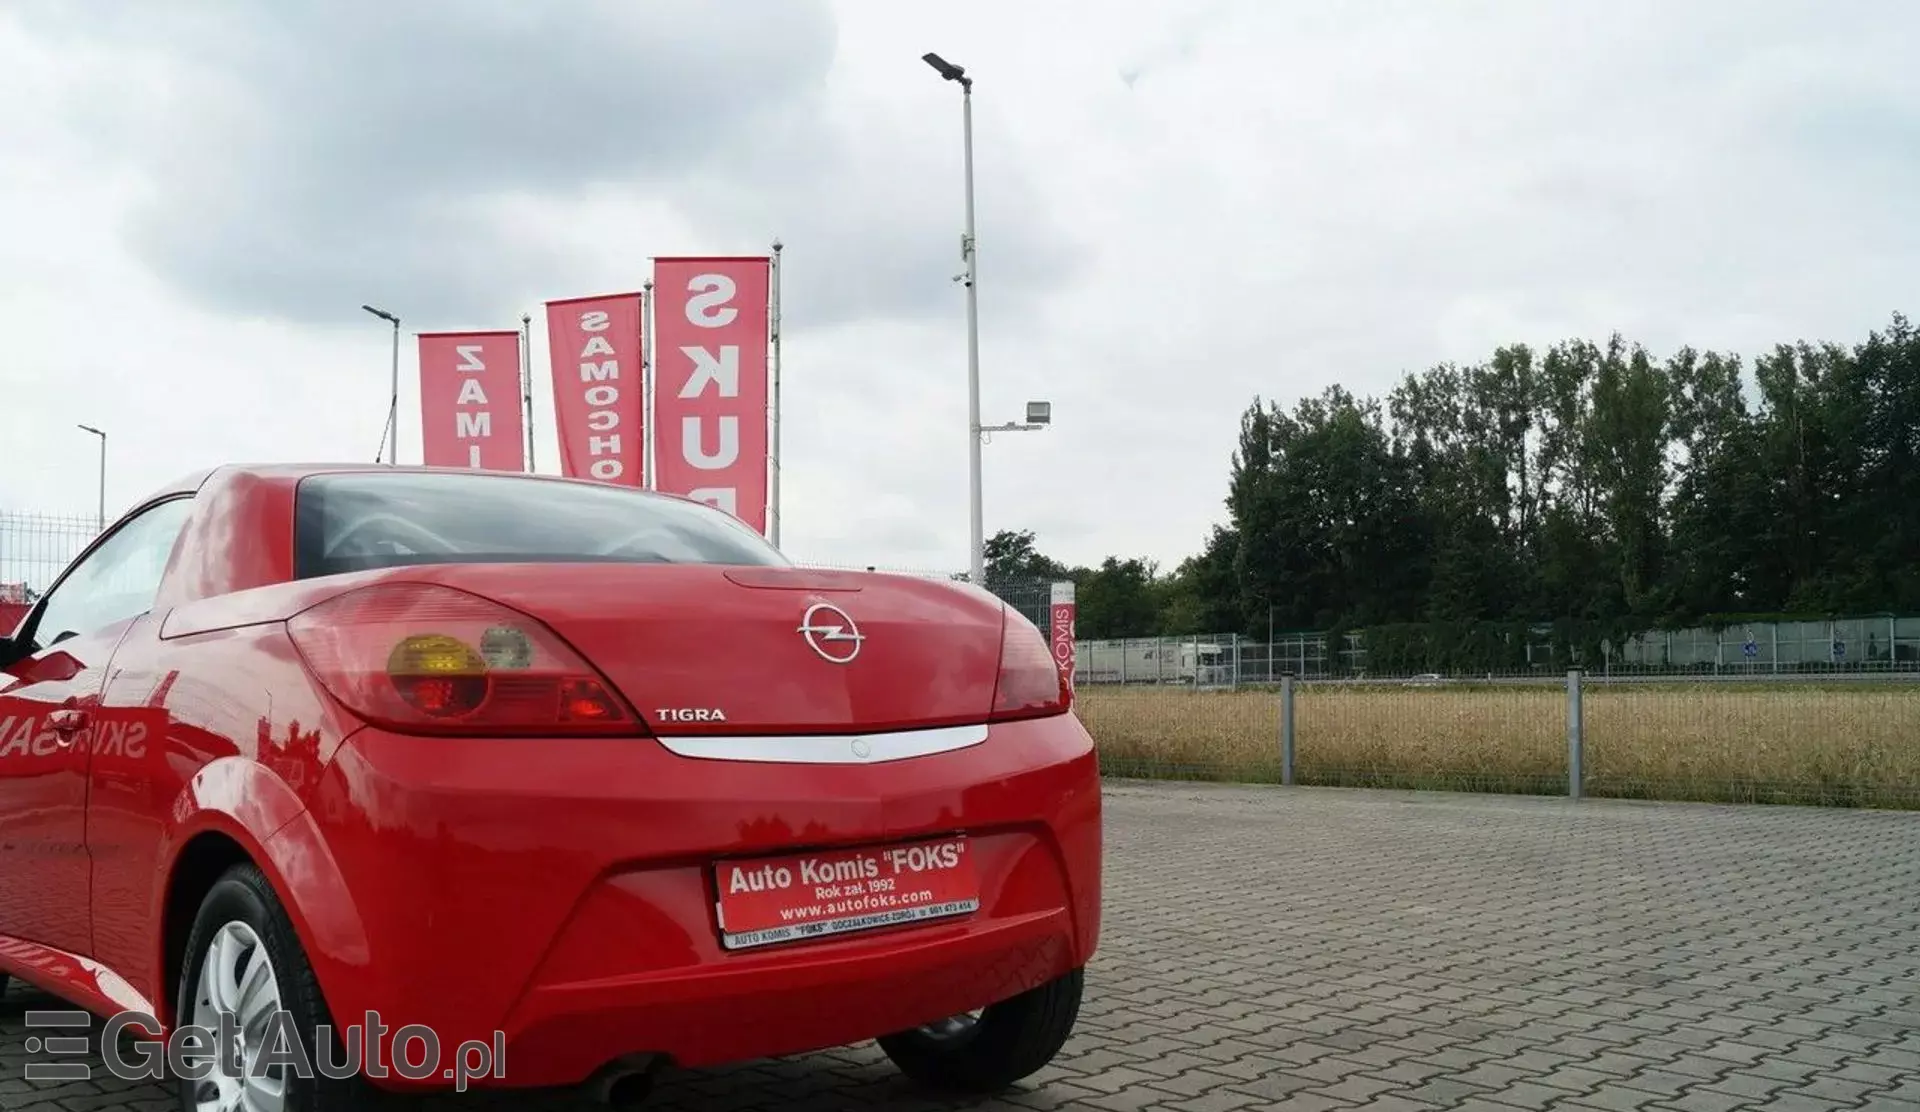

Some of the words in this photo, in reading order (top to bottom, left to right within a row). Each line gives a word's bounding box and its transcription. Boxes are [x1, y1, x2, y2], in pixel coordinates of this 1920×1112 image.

[1055, 608, 1069, 671] KOMIS
[655, 708, 726, 721] TIGRA
[730, 864, 792, 893] Auto
[800, 854, 878, 885] Komis
[883, 843, 965, 873] "FOKS"
[815, 882, 841, 899] Rok
[844, 880, 866, 896] zał.
[868, 879, 896, 893] 1992
[780, 889, 933, 920] www.autofoks.com
[734, 934, 760, 946] AUTO
[762, 929, 791, 941] KOMIS
[795, 922, 827, 935] "FOKS"
